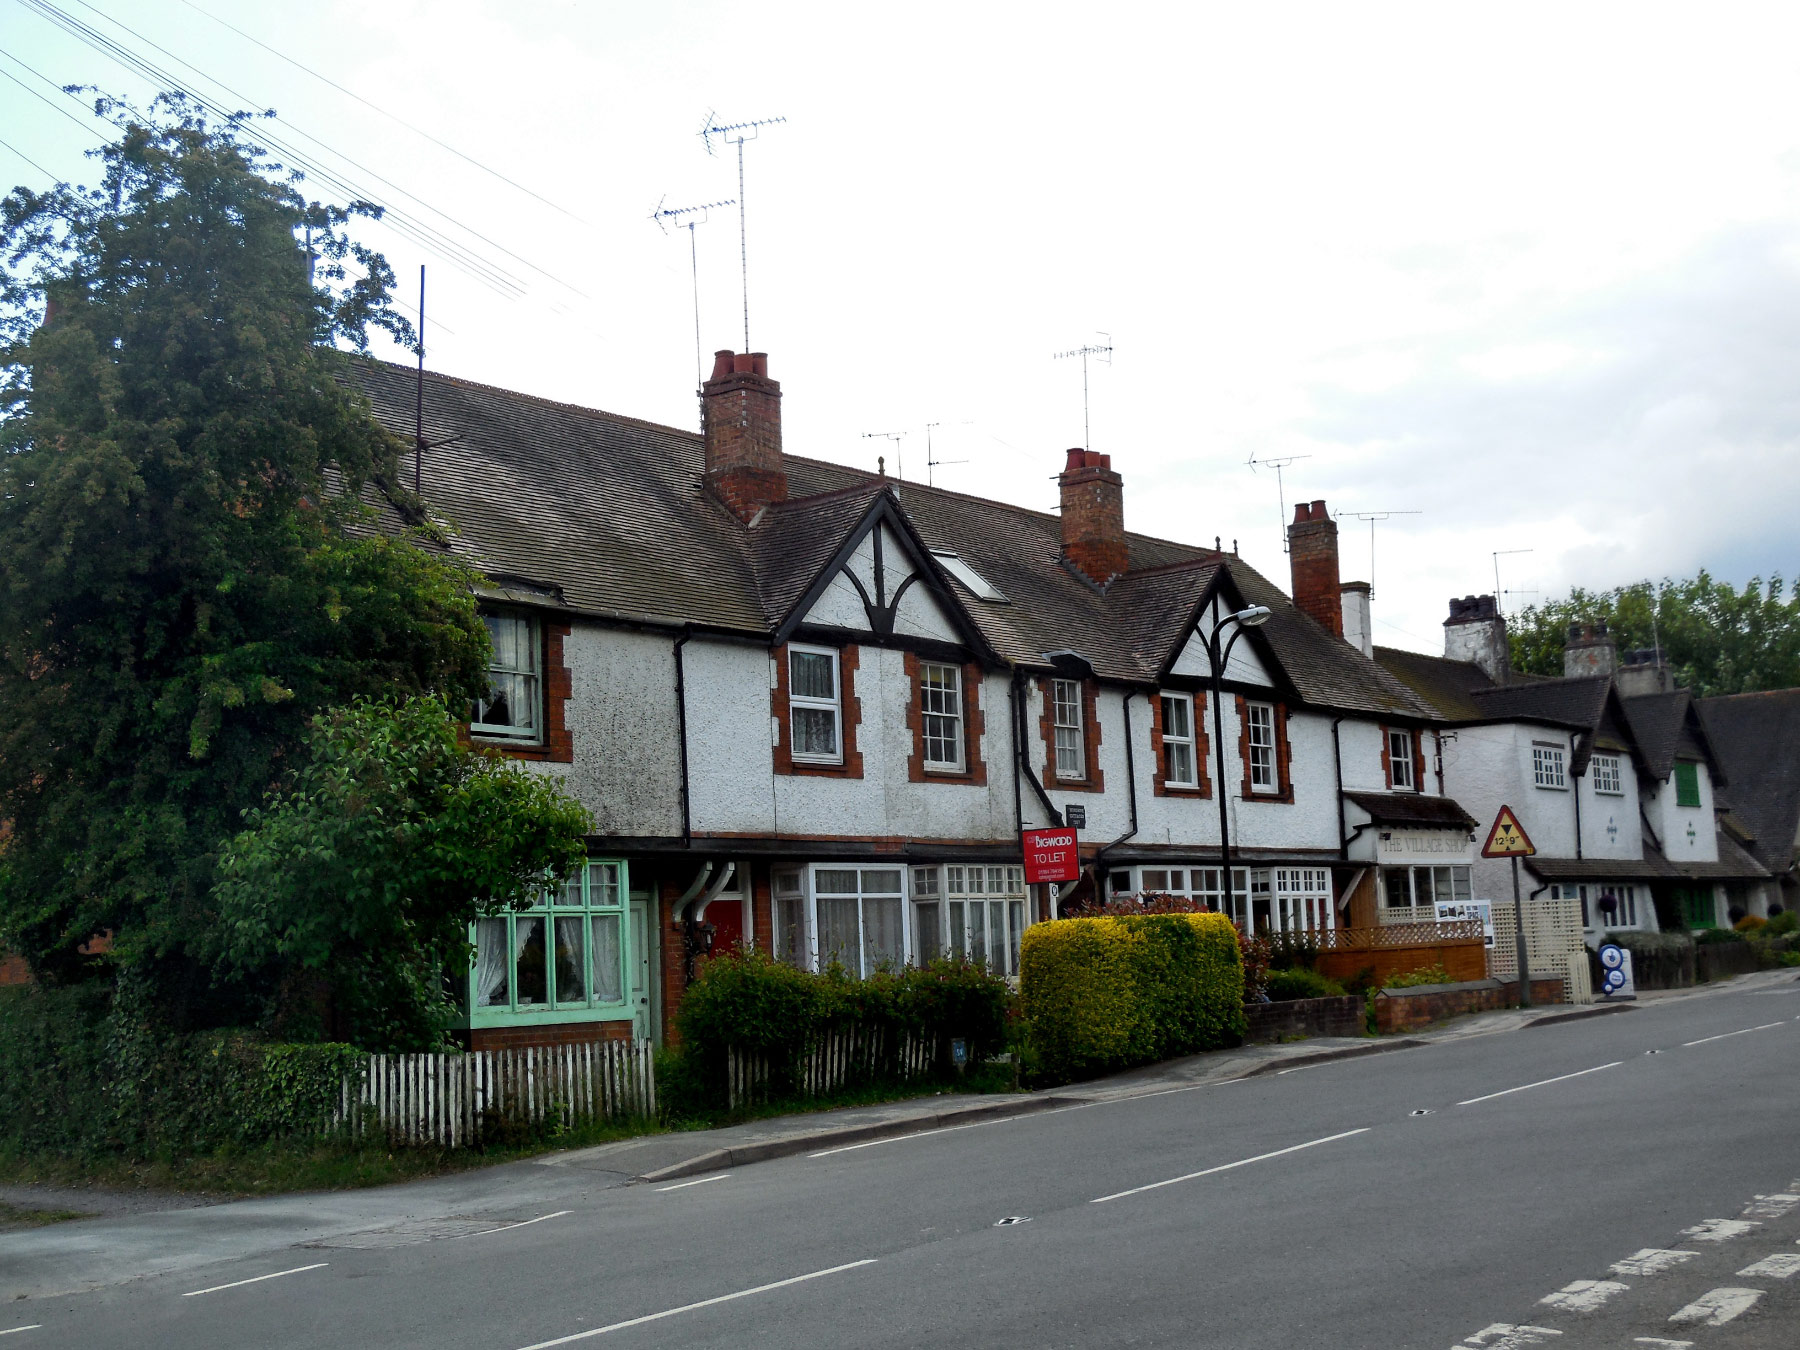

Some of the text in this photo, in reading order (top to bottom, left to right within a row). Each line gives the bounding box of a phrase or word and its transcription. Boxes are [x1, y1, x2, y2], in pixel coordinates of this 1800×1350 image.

[1384, 837, 1467, 853] THE VILLAGE SHOP
[1033, 851, 1066, 864] TO LET
